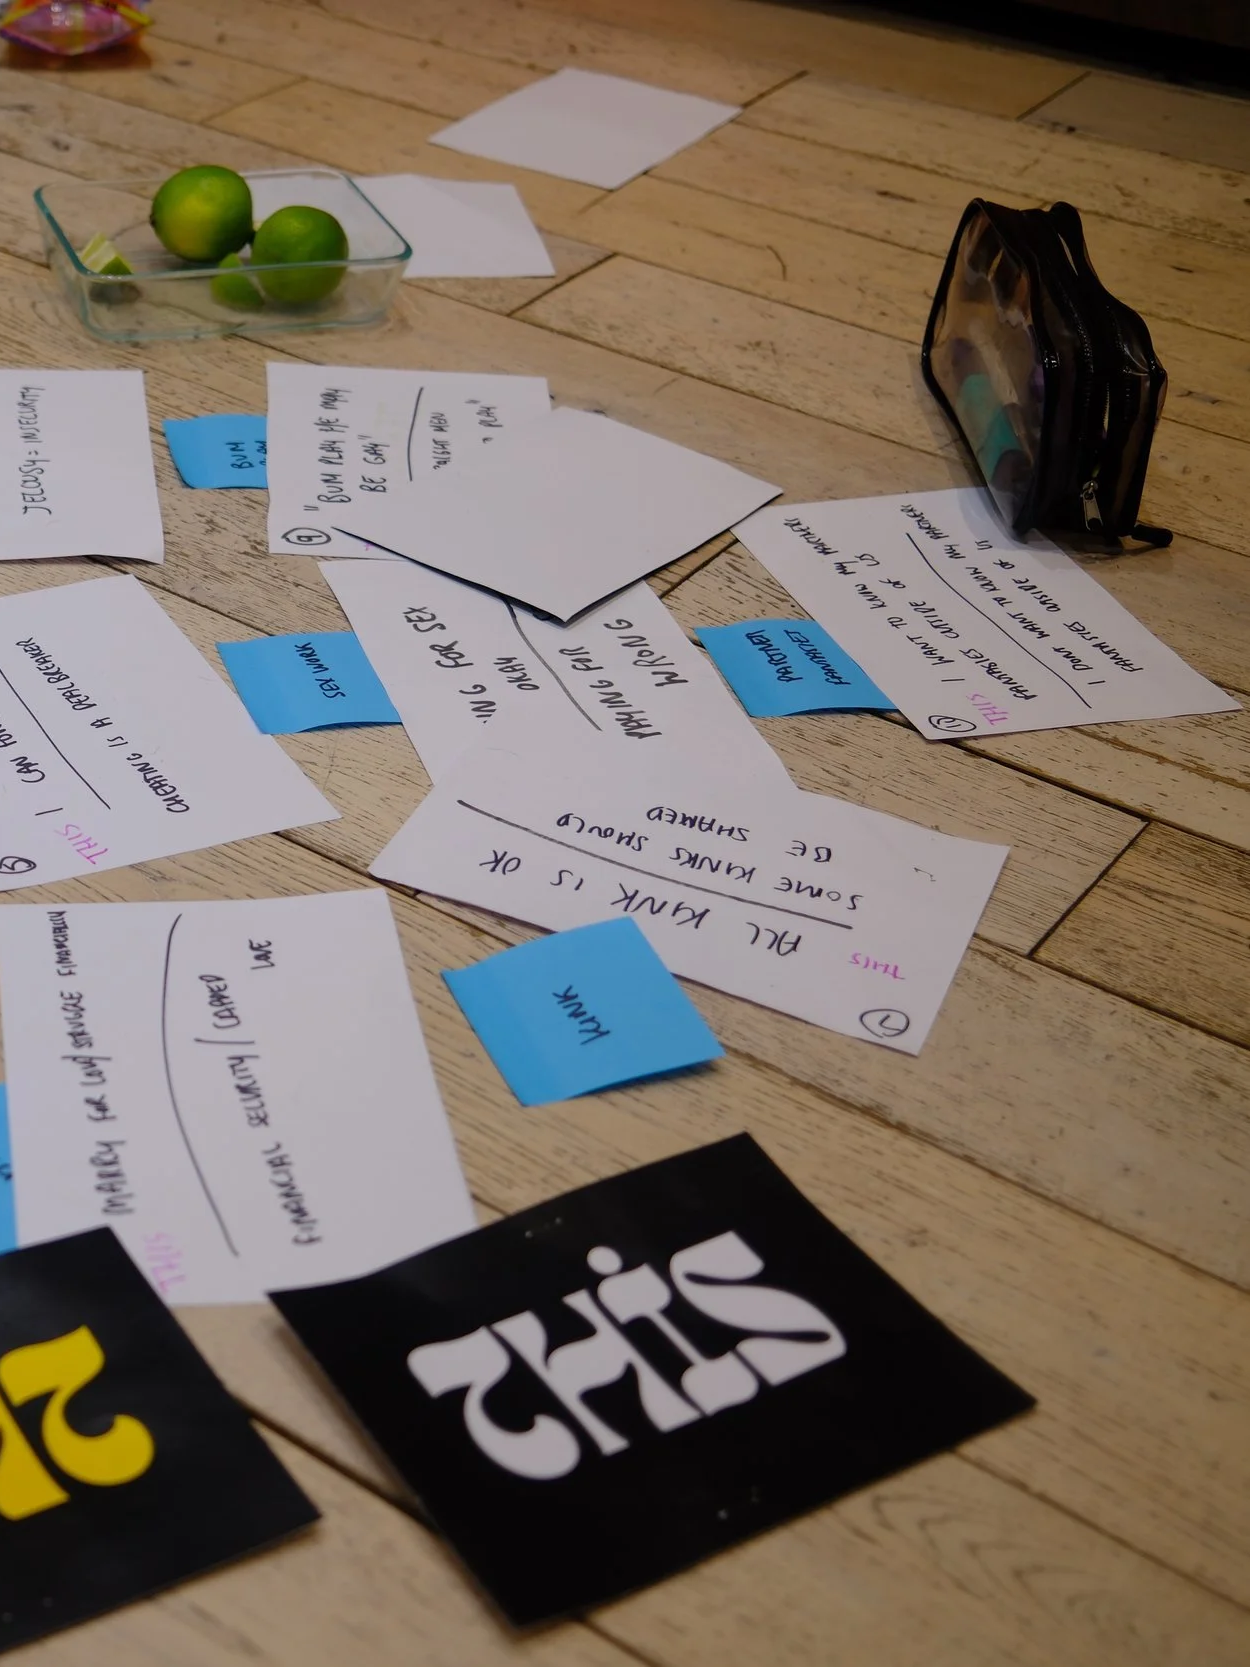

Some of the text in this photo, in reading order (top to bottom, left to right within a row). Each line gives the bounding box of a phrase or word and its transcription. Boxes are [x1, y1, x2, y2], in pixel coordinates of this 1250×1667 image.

[319, 388, 352, 410] MAY
[17, 386, 46, 443] INSECURITY
[314, 418, 349, 433] HE
[429, 411, 450, 433] MEN
[225, 442, 255, 470] BUM
[318, 440, 346, 466] PLAY
[359, 476, 387, 493] BE
[944, 544, 966, 560] MY
[975, 539, 993, 551] US
[833, 560, 859, 576] MY
[854, 553, 880, 567] US
[965, 566, 1001, 593] KNOW
[855, 583, 887, 609] KNOW
[992, 596, 1013, 608] TO
[1012, 577, 1061, 613] OUTSIDE
[402, 606, 446, 633] SEX
[886, 616, 908, 629] TO
[1006, 612, 1051, 639] WANT
[429, 640, 474, 668] FOR
[603, 618, 689, 687] WRONG
[745, 629, 804, 683] PARTNER
[906, 634, 955, 666] WANT
[294, 641, 346, 698] SEX WORK
[493, 656, 540, 691] OKAY
[958, 648, 1038, 700] FANTASIES
[558, 646, 662, 739] PAYING FOR
[90, 717, 113, 729] A
[966, 693, 1010, 726] THIS
[107, 736, 129, 748] IS
[9, 756, 46, 784] CAN
[126, 752, 190, 813] CHEATING
[34, 807, 64, 816] I
[54, 823, 109, 865] THIS
[785, 840, 832, 863] BE
[556, 813, 863, 910] SOME KINKS SHOULD
[479, 850, 801, 956] ALL KINK IS OK
[248, 938, 276, 970] LOVE
[848, 952, 905, 979] THIS
[551, 985, 611, 1046] KINK
[84, 1093, 118, 1122] FOR
[89, 1139, 136, 1216] MARRY
[261, 1141, 323, 1247] FINANCIAL
[142, 1232, 189, 1294] THIS
